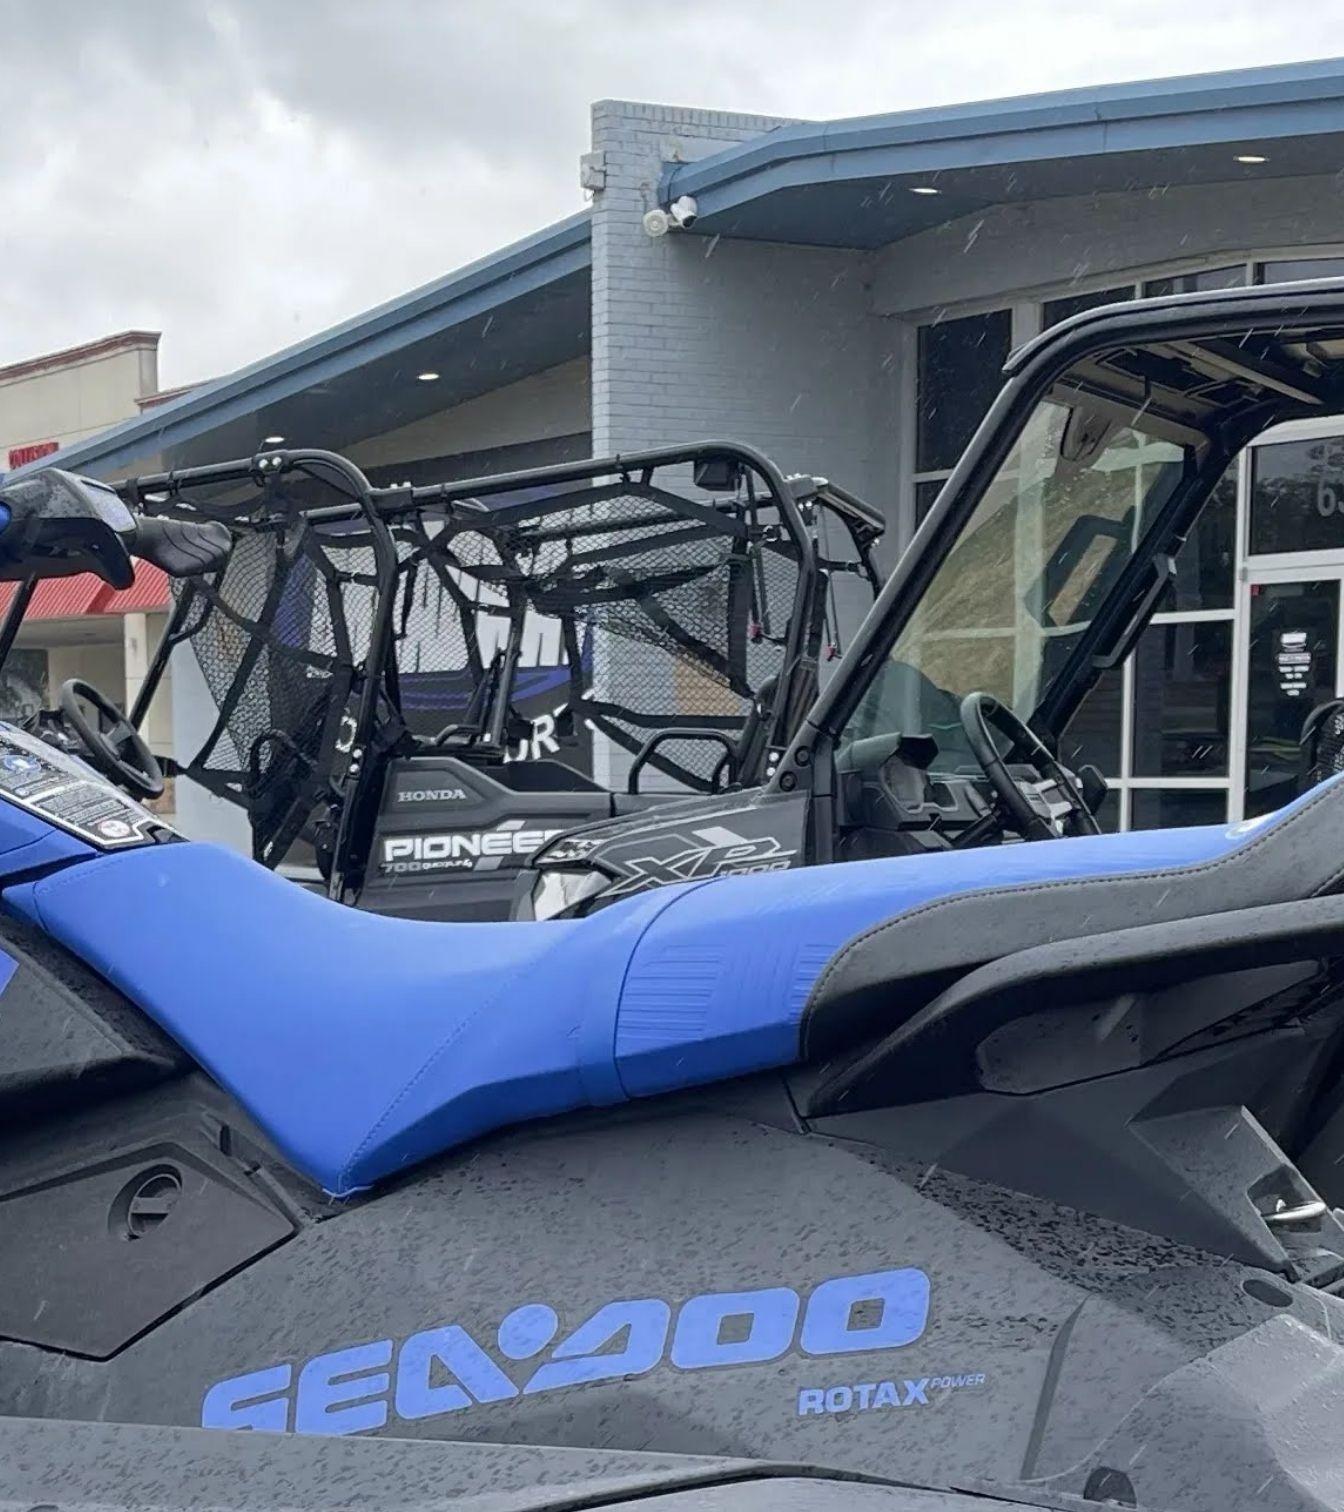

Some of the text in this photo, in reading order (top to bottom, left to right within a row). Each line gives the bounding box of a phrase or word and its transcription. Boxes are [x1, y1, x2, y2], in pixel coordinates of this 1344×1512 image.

[397, 788, 466, 803] HONDA
[383, 829, 564, 862] PIONEE
[798, 1373, 987, 1416] ROTAX POWER
